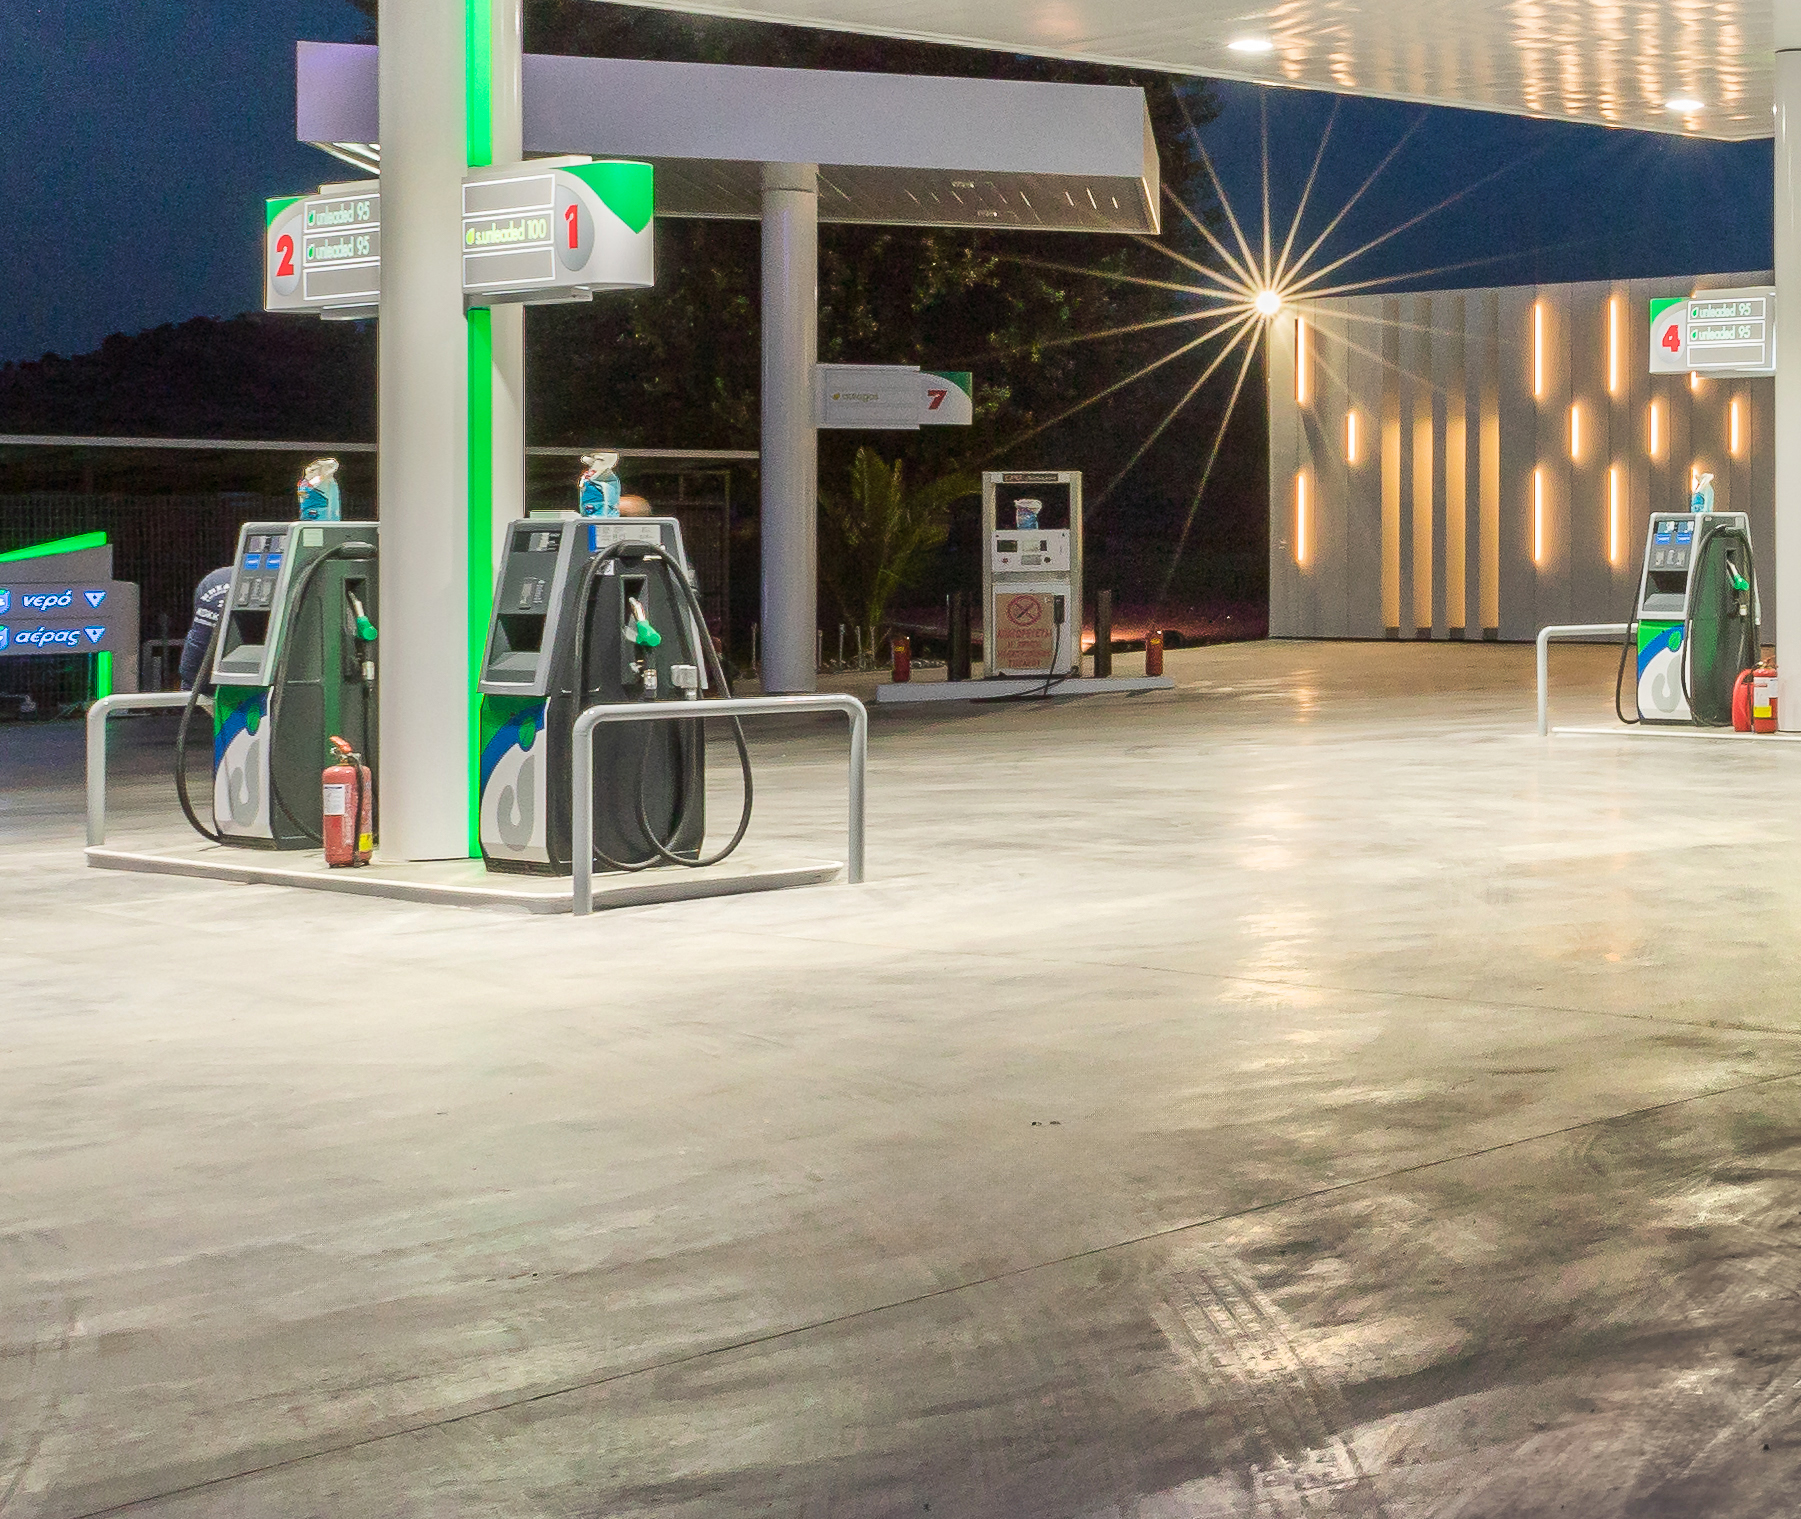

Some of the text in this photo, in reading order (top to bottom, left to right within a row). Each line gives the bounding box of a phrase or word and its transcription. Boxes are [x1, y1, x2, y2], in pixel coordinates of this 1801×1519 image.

[316, 201, 370, 226] unleaded 95
[527, 218, 547, 239] 100
[564, 204, 578, 249] 1
[276, 234, 294, 277] 2
[315, 235, 370, 260] unleaded 95
[1699, 302, 1751, 318] unleaded 95
[1661, 324, 1681, 353] 4
[1698, 325, 1751, 341] unleaded 95
[927, 389, 948, 411] 7
[22, 588, 73, 612] νερό
[14, 626, 82, 648] αέρας
